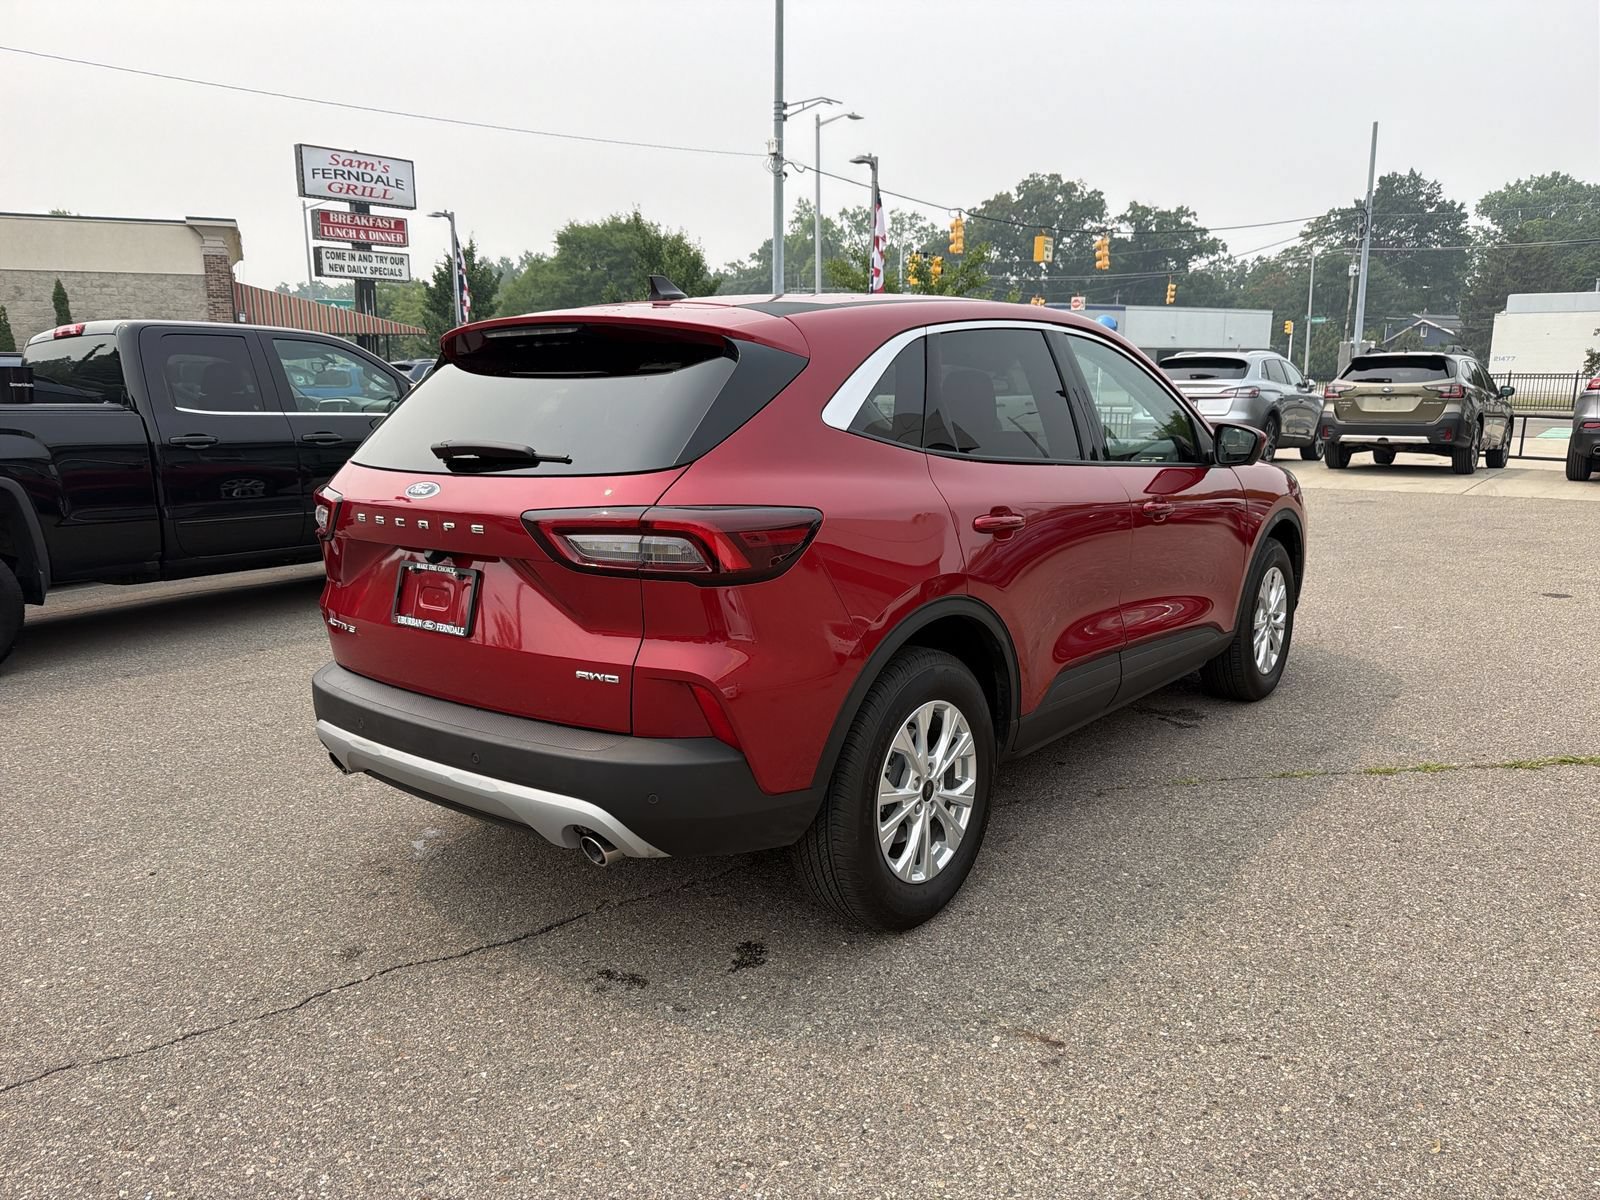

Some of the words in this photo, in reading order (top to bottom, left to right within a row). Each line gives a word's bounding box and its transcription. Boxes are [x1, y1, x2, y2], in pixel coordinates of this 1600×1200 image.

[328, 153, 390, 174] Sam's
[311, 168, 405, 190] FERNDALE
[327, 181, 394, 200] GRILL
[329, 213, 396, 229] BREAKFAST
[323, 225, 356, 239] LUNCH
[358, 230, 367, 240] &
[368, 231, 404, 243] DINNER
[324, 250, 347, 262] COME
[348, 253, 356, 263] IN
[357, 253, 374, 264] AND
[375, 254, 389, 265] TRY
[389, 255, 405, 266] OUR
[328, 262, 347, 273] NEW
[347, 263, 368, 275] DAILY
[369, 265, 403, 278] SPECIALS
[356, 512, 485, 534] ESCAPE
[394, 615, 423, 627] UBURBAN
[435, 623, 465, 636] FERNDALE
[575, 670, 619, 684] AWD
